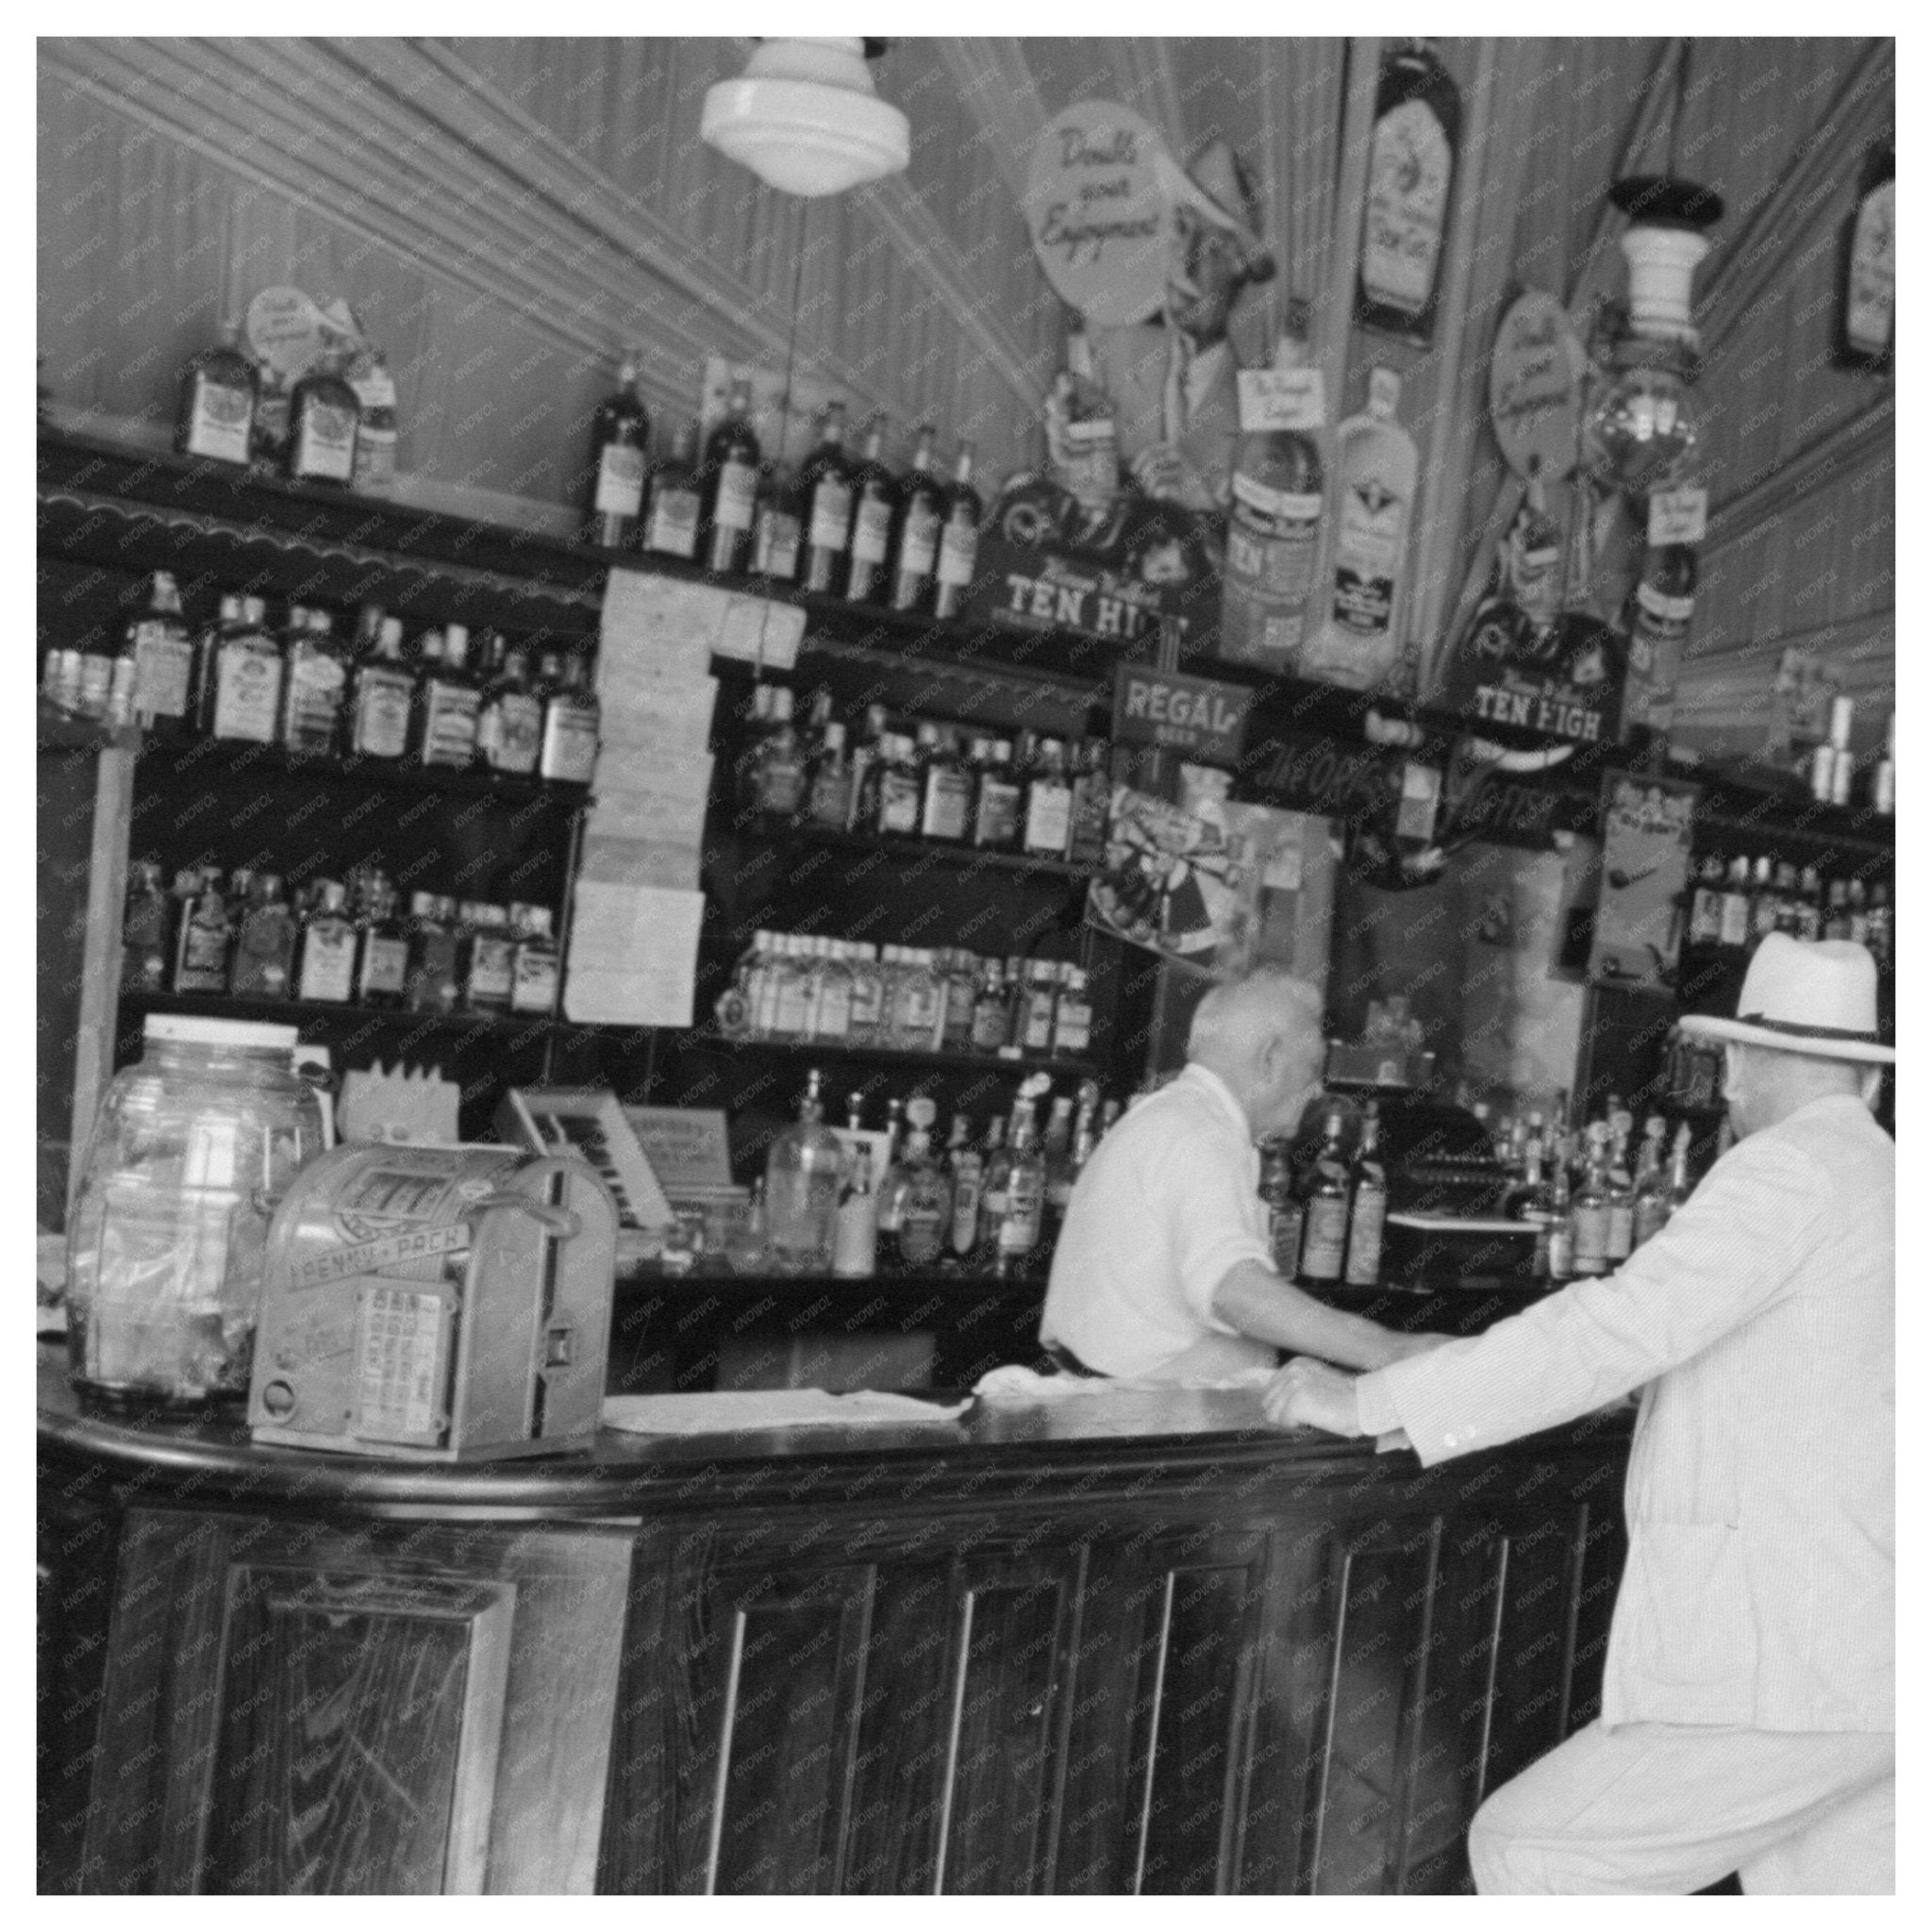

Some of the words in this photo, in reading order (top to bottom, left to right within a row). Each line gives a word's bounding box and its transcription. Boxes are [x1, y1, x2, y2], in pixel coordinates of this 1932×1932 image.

[1006, 573, 1086, 626] TEN
[1126, 679, 1239, 735] REGAL
[1475, 685, 1532, 726] TEN
[396, 1227, 459, 1260] PACK
